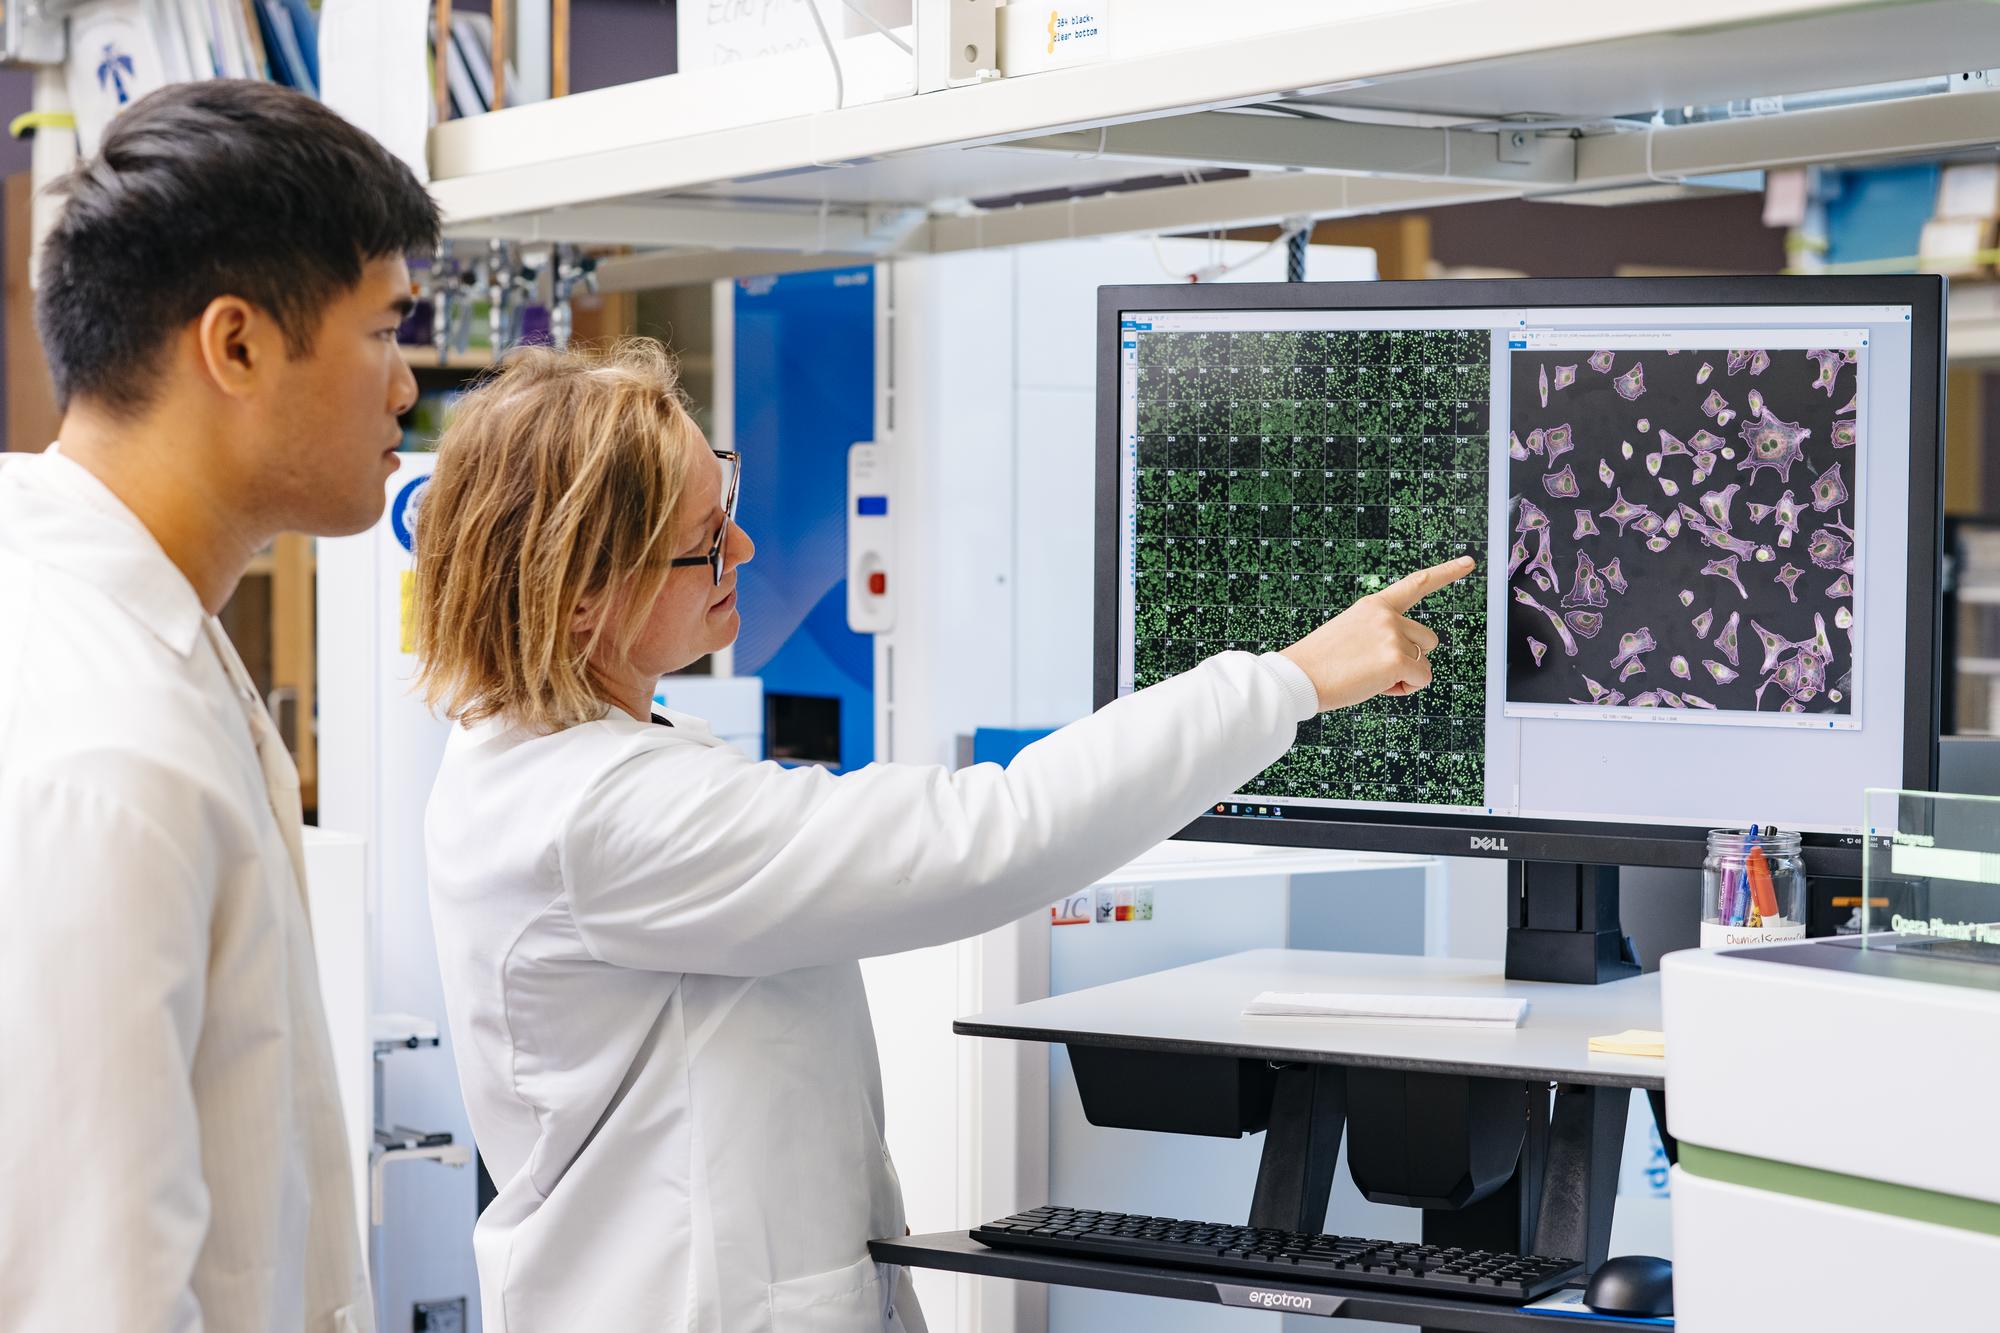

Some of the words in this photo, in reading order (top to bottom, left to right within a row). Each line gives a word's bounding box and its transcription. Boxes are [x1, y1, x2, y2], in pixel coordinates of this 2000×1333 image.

[1053, 32, 1072, 42] clear
[1075, 27, 1098, 39] bottom
[1471, 836, 1508, 851] DELL
[1249, 1291, 1312, 1310] ergotron
